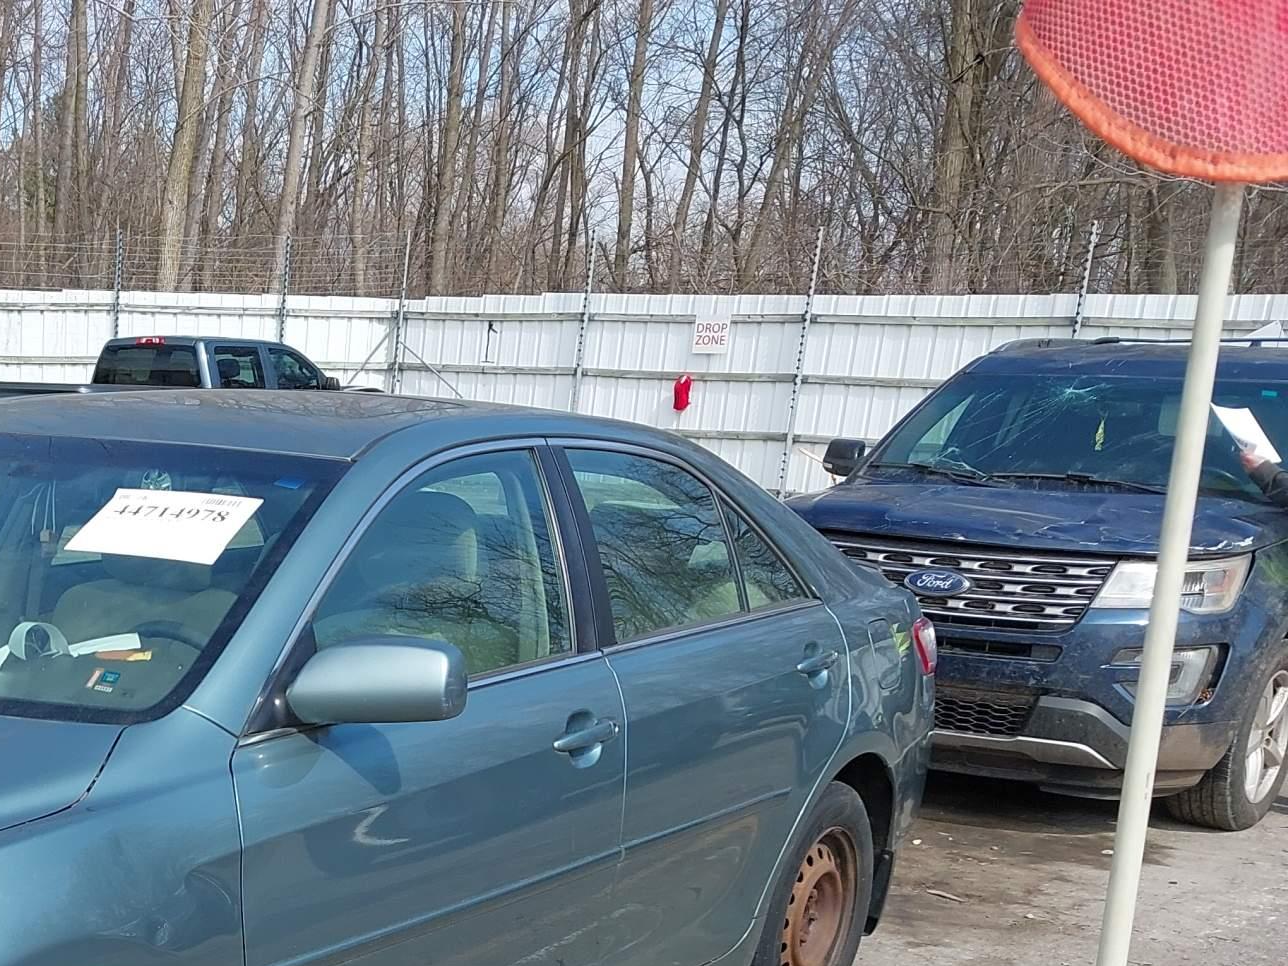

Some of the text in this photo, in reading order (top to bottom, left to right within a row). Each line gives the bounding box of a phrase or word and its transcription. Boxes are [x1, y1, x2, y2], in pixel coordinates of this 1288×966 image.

[696, 323, 728, 334] DROP
[695, 334, 727, 346] ZONE
[114, 504, 230, 523] 44714978
[917, 573, 953, 589] Ford
